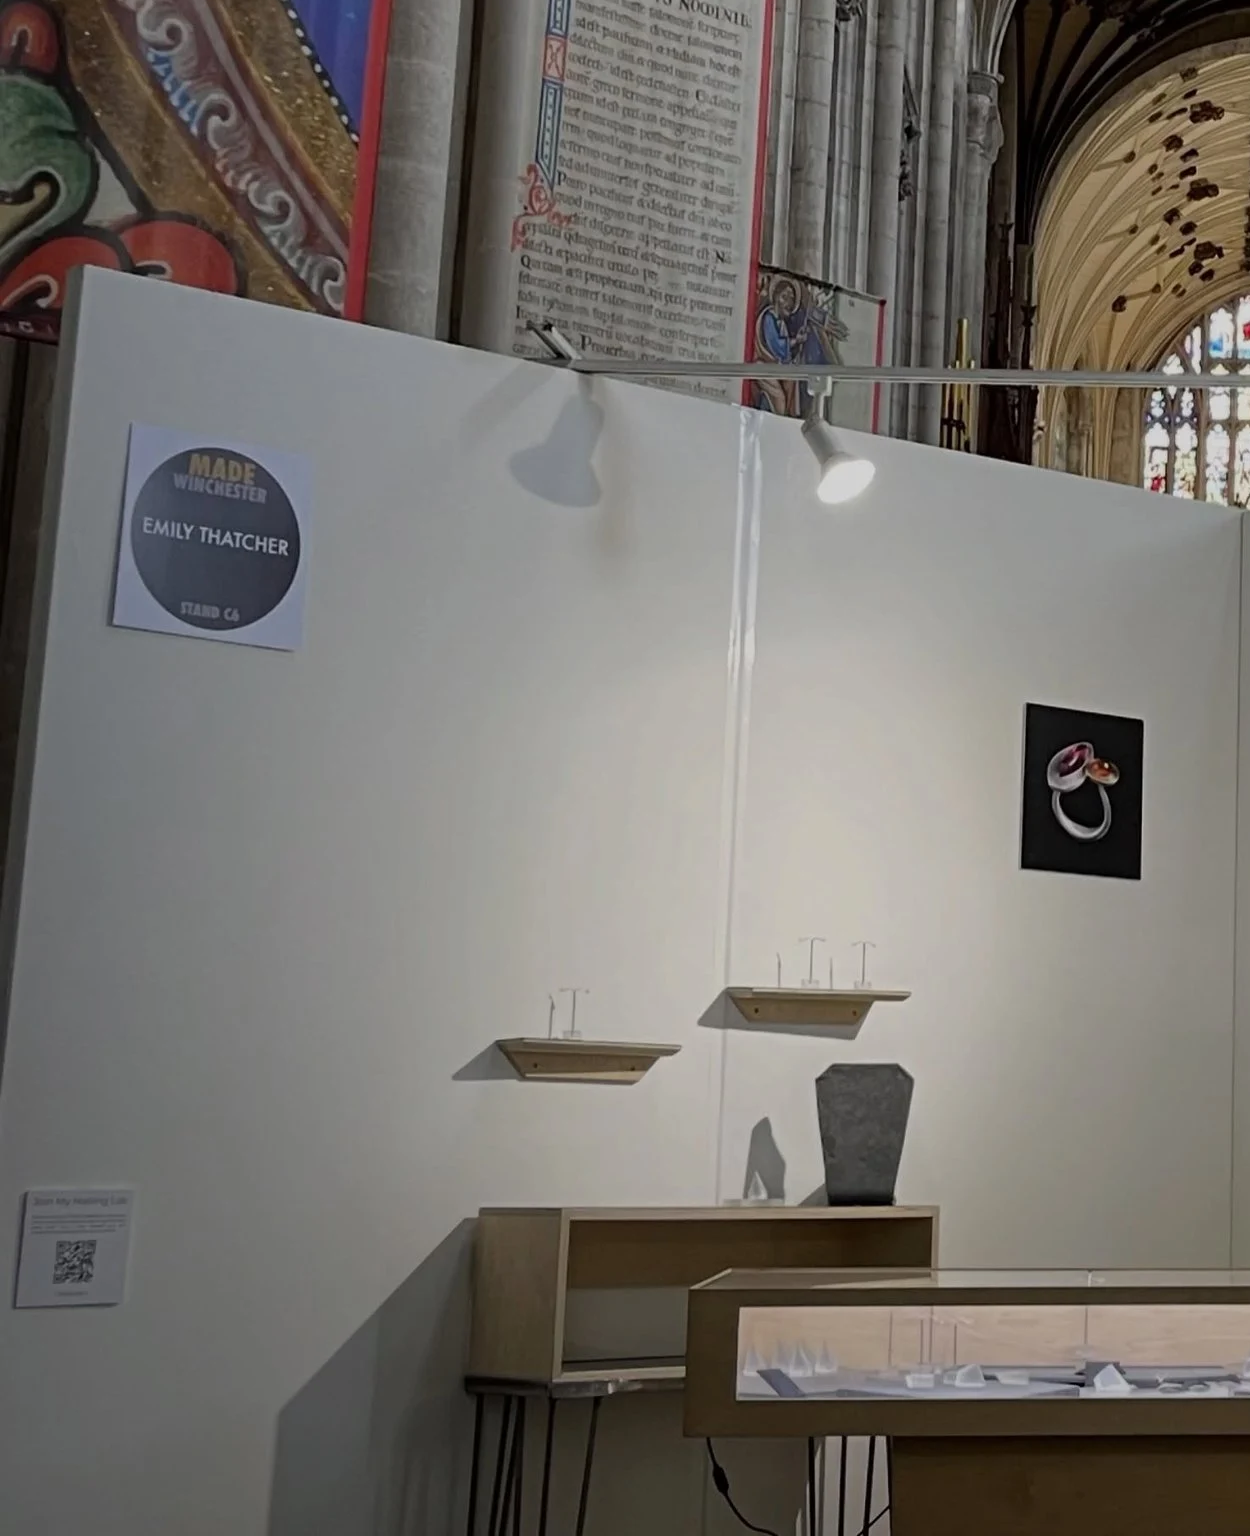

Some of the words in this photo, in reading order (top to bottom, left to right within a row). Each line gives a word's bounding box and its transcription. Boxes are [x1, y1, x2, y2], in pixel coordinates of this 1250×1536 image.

[188, 453, 257, 484] MADE
[173, 473, 268, 504] WINCHESTER
[142, 517, 194, 540] EMILY
[200, 526, 289, 556] THATCHER
[180, 601, 220, 621] STAND
